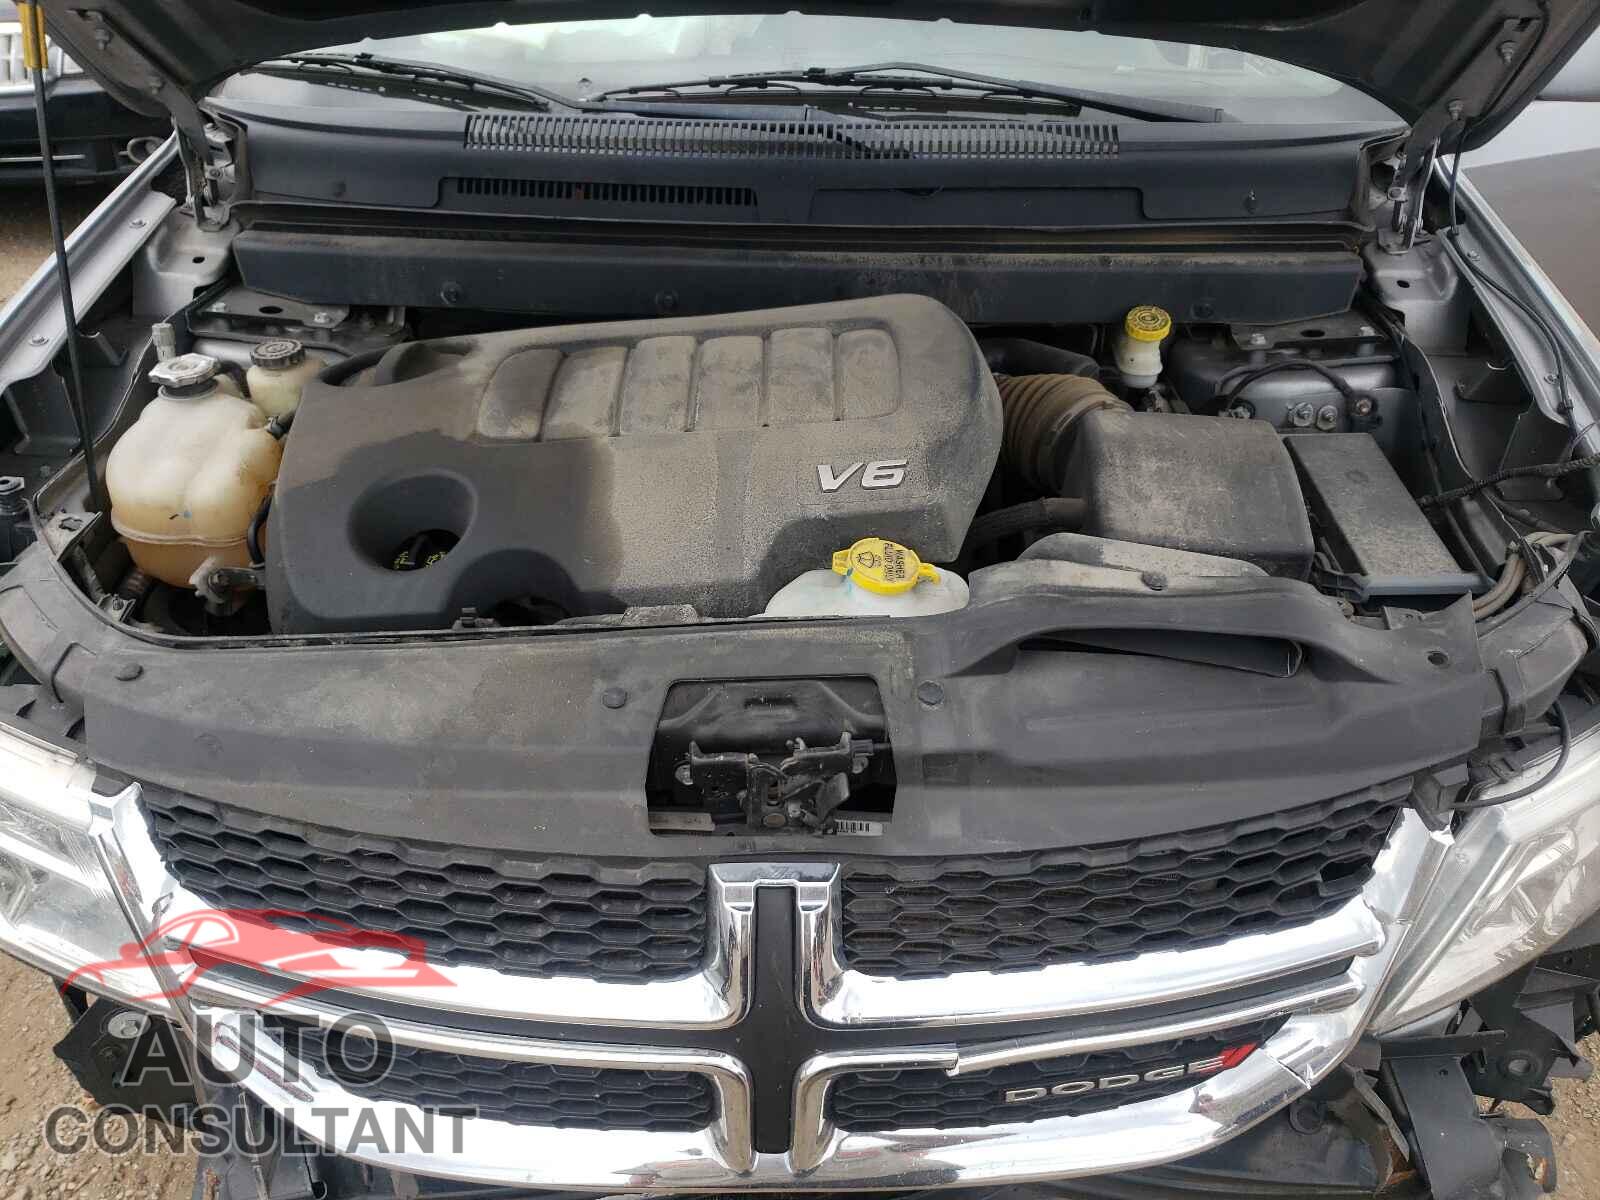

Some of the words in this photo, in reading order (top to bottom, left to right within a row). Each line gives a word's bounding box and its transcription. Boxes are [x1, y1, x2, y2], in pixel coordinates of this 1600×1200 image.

[817, 460, 909, 493] V6
[895, 549, 905, 579] WASHER
[1005, 1055, 1226, 1102] DODGE
